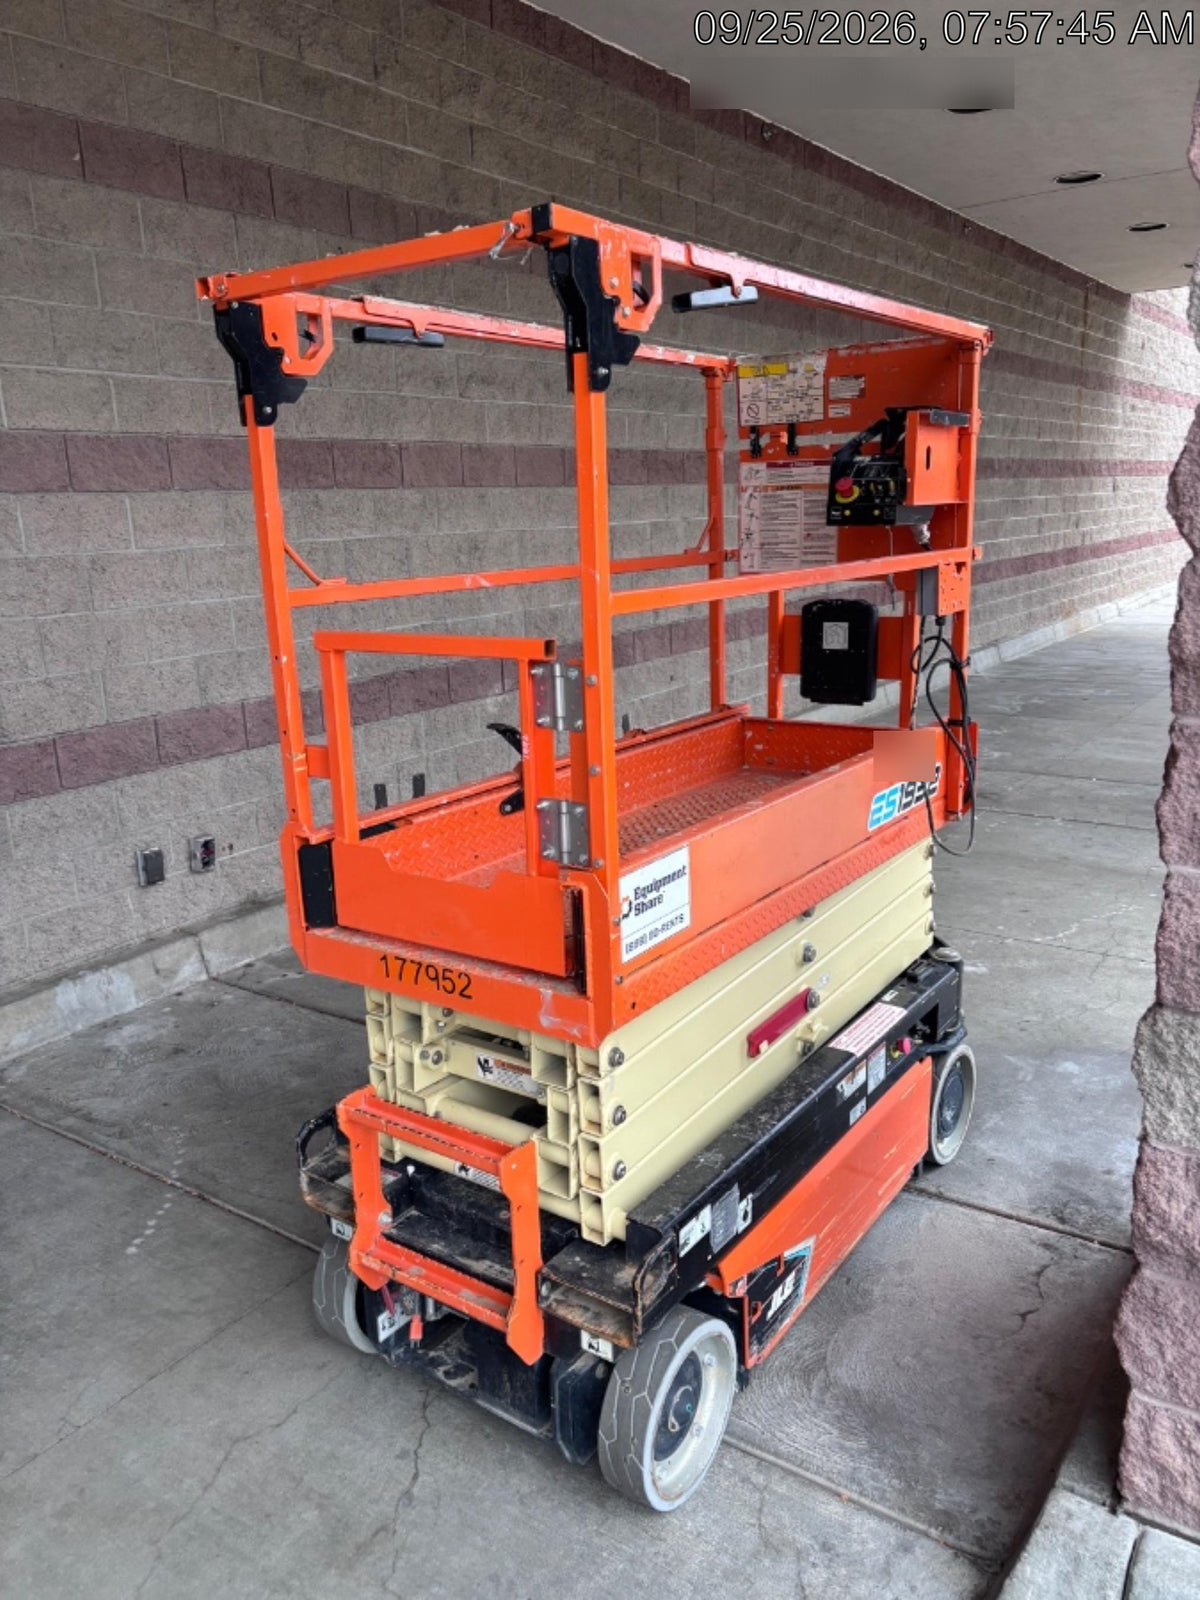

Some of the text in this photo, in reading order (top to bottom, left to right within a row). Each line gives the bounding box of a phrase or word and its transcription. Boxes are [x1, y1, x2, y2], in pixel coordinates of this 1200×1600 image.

[633, 864, 688, 900] Equipment
[634, 893, 664, 917] Share
[379, 954, 474, 1000] 177952
